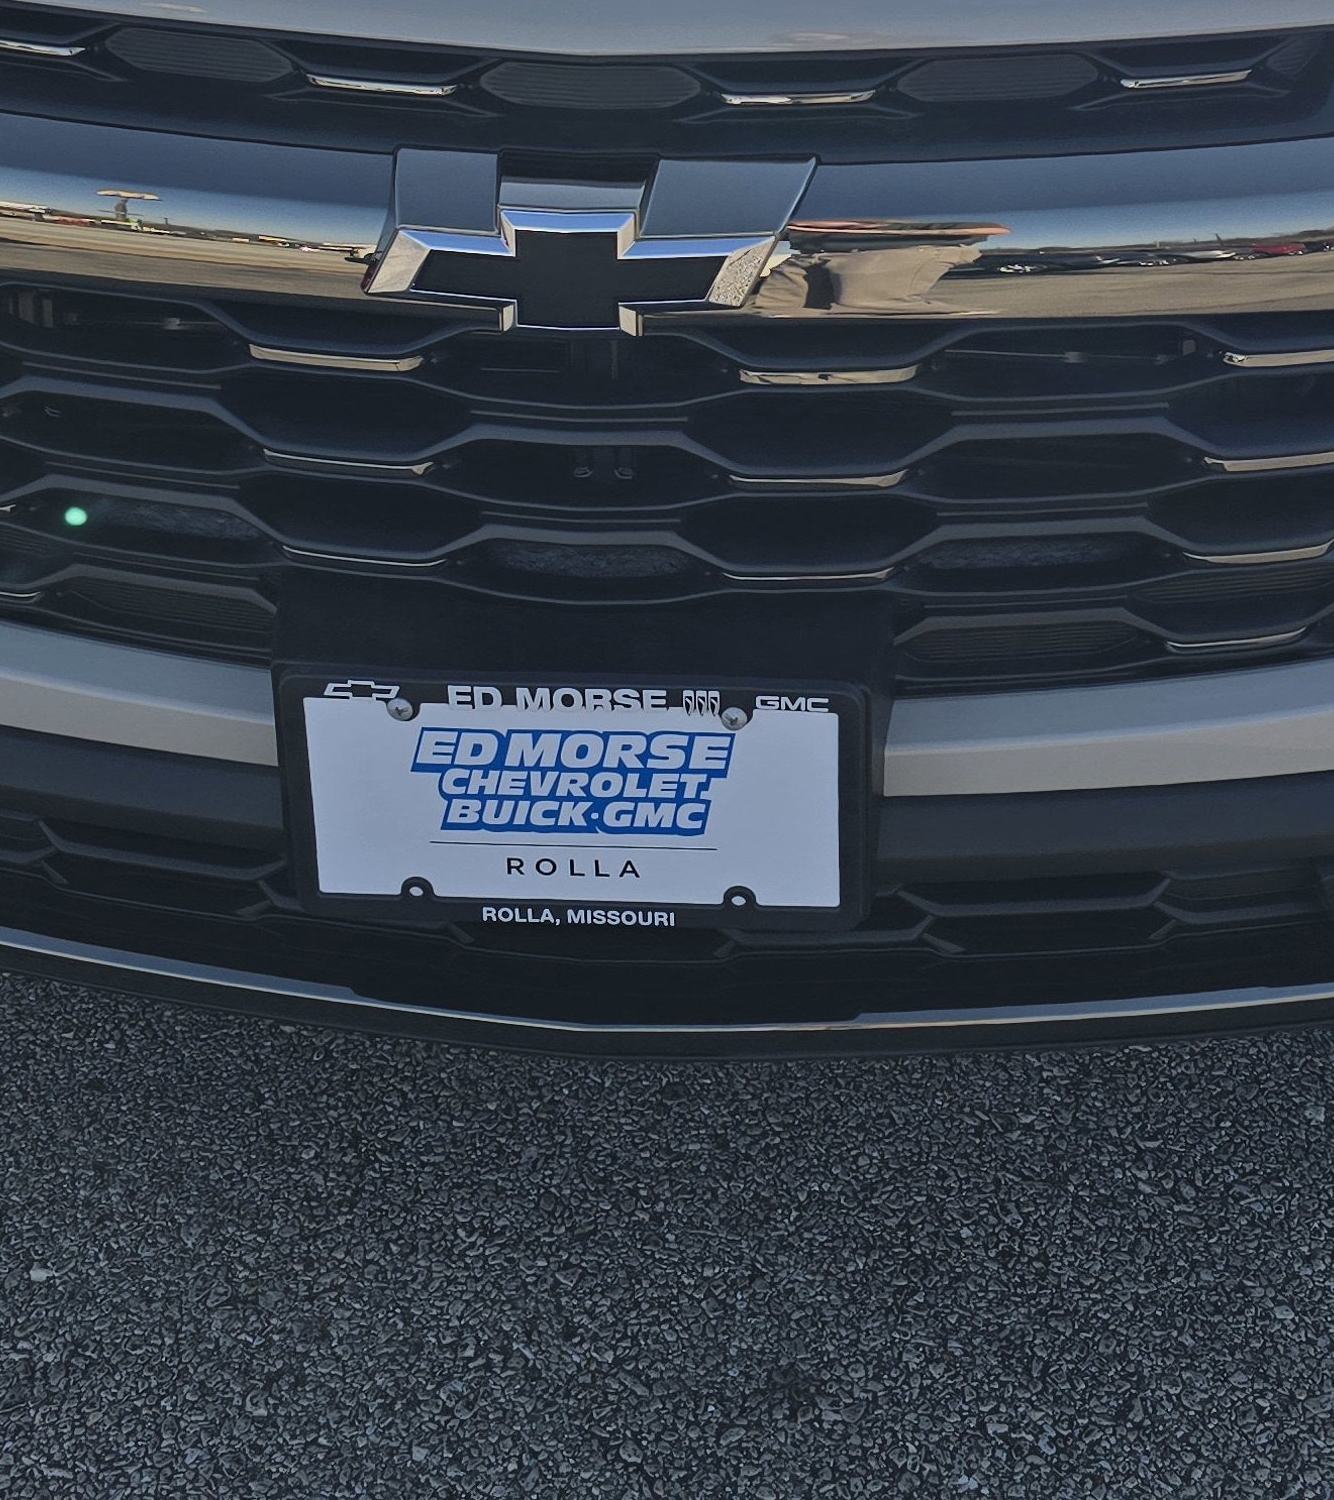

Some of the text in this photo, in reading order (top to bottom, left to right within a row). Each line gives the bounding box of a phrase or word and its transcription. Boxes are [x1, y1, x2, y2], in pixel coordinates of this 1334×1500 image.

[447, 684, 667, 713] ED MORSE
[755, 695, 829, 713] GMC
[416, 730, 732, 770] ED MORSE
[441, 767, 708, 799] CHEVROLET
[506, 857, 641, 878] ROLLA
[482, 906, 676, 927] ROLLA, MISSOURI
